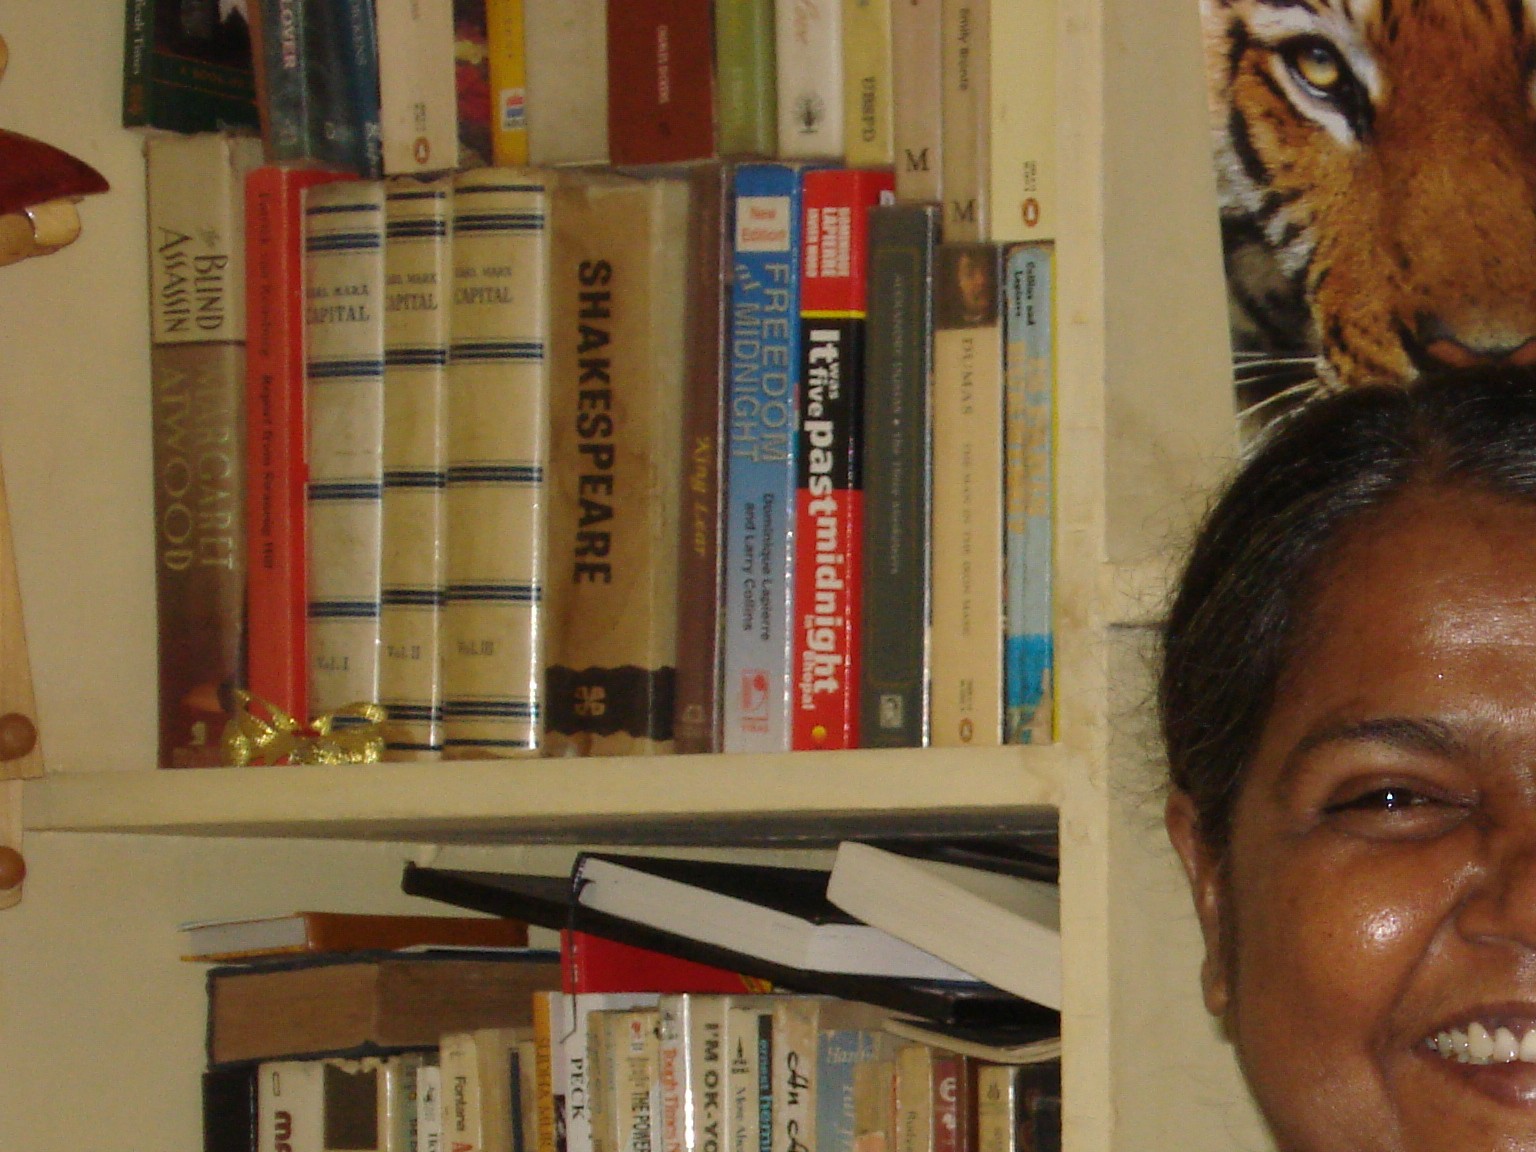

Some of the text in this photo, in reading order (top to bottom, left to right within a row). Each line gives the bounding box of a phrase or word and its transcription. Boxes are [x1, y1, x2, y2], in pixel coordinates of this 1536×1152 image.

[741, 226, 790, 244] Edition
[750, 206, 777, 222] New
[820, 207, 838, 278] LAPIERRE
[156, 226, 192, 334] ASSASSIN
[192, 253, 230, 332] BLIND
[731, 301, 761, 464] MIDNIGHT
[760, 263, 790, 464] FREEDOM
[960, 336, 974, 417] DUMAS
[573, 258, 613, 585] SHAKESPEARE
[160, 365, 194, 571] ATWOOD
[803, 328, 845, 696] It was five past midnight
[739, 502, 759, 632] and Larry Collins
[757, 491, 776, 641] Dominique Lapierre
[660, 1048, 679, 1090] Tough
[703, 1022, 720, 1063] I'M
[785, 1050, 810, 1107] An
[453, 1075, 468, 1133] Fontana
[570, 1057, 585, 1120] PECK
[631, 1091, 651, 1112] THE
[664, 1094, 680, 1140] Times
